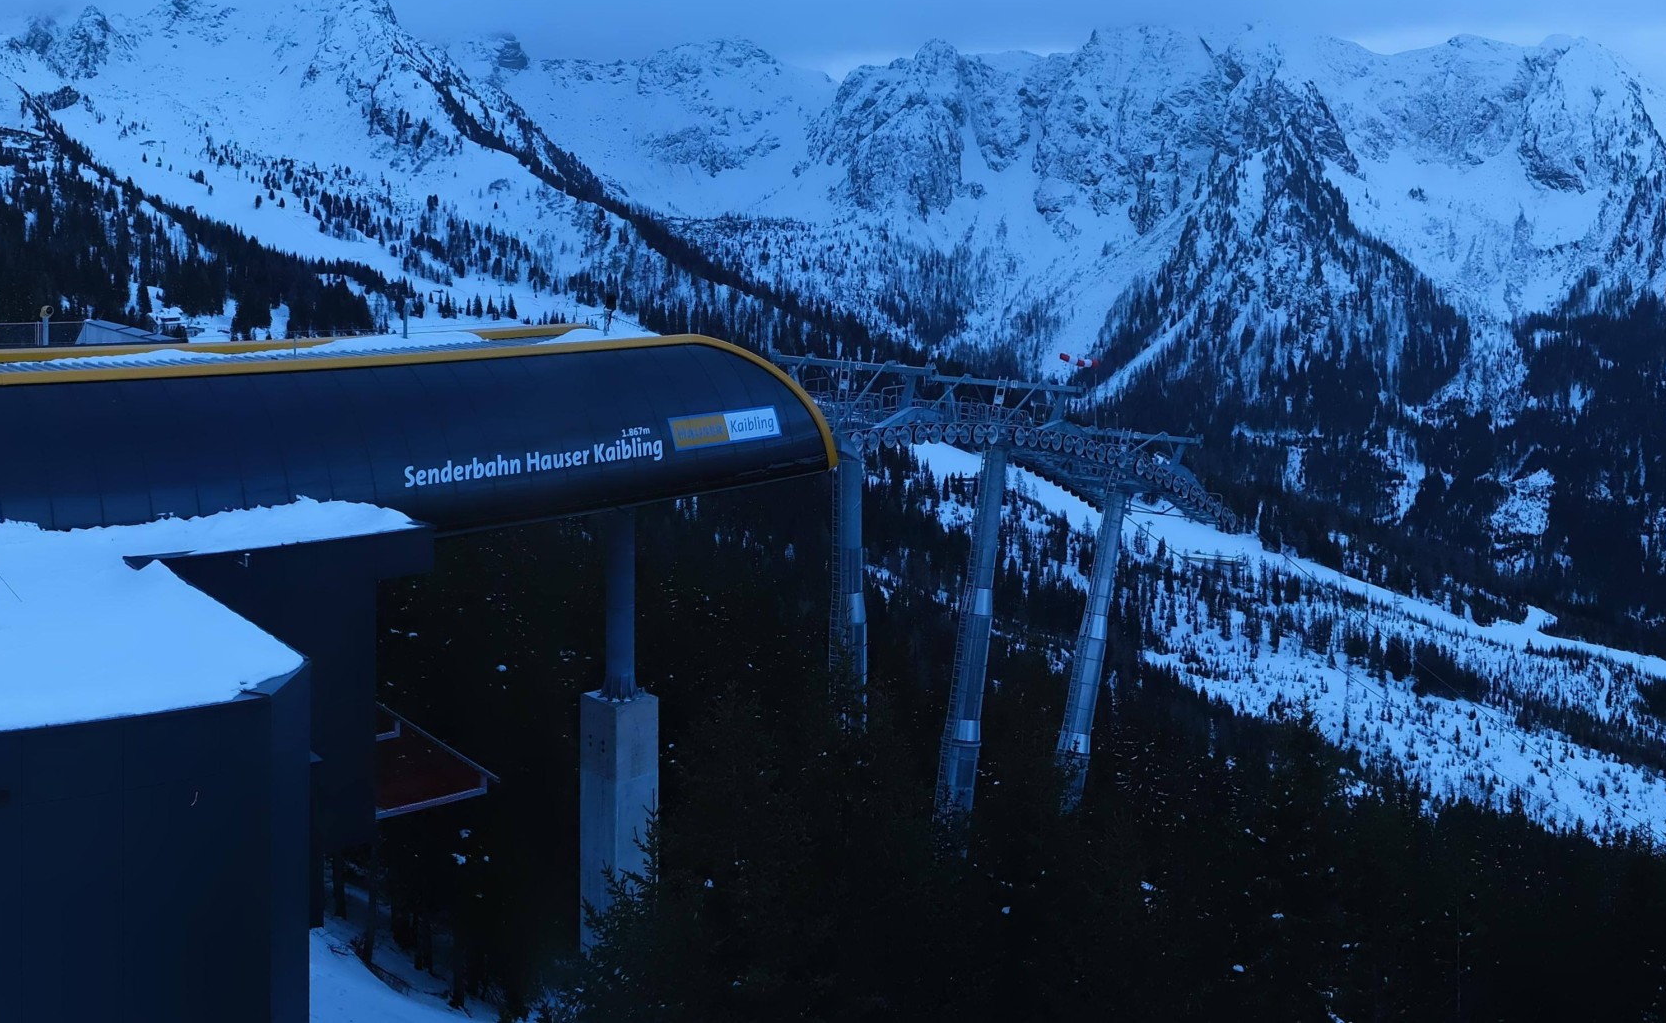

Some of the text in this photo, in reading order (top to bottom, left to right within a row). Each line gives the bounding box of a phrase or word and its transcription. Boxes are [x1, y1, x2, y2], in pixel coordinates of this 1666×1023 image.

[621, 427, 651, 437] 1.867m
[730, 416, 775, 433] Kaibling
[404, 436, 664, 488] Senderbahn Hauser Kaibling
